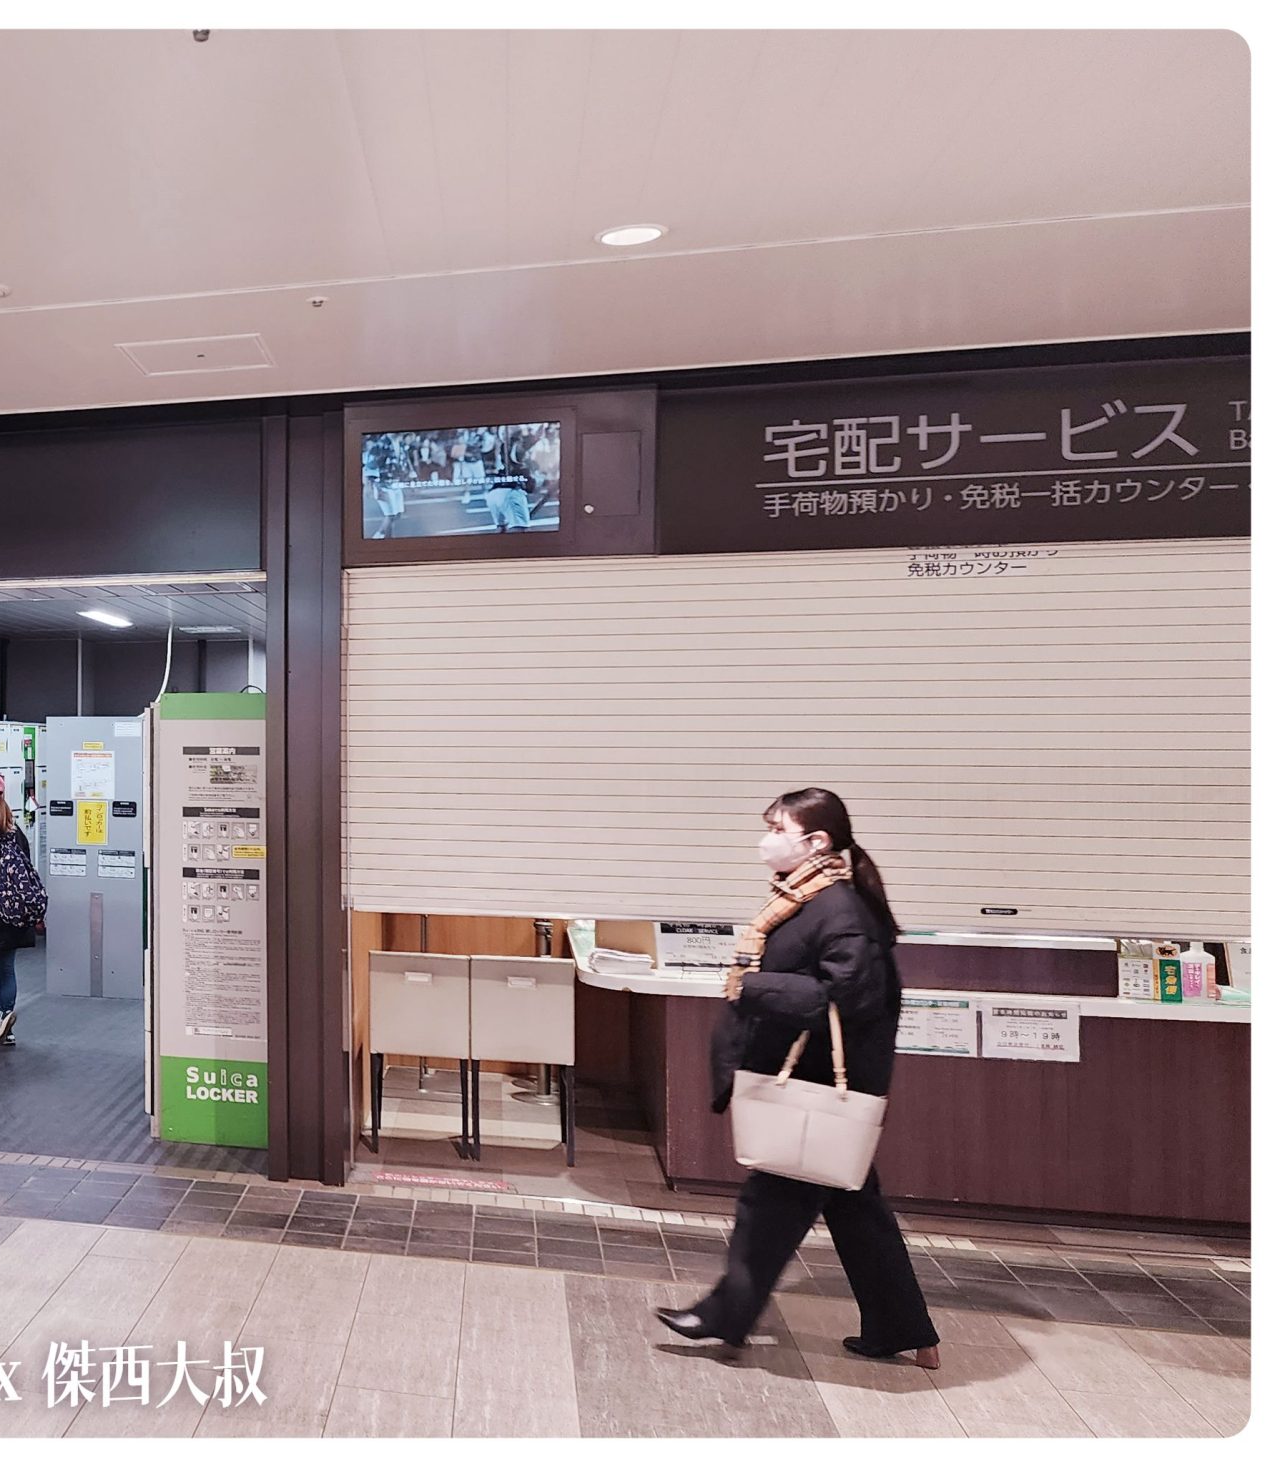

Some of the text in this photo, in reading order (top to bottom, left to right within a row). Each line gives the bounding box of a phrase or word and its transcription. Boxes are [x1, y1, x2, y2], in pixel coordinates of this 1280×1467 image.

[1228, 401, 1251, 421] T
[763, 399, 1200, 478] 宅配サービス
[907, 560, 1027, 577] 免税カウンター
[186, 1066, 258, 1087] Suica
[186, 1085, 259, 1104] LOCKER
